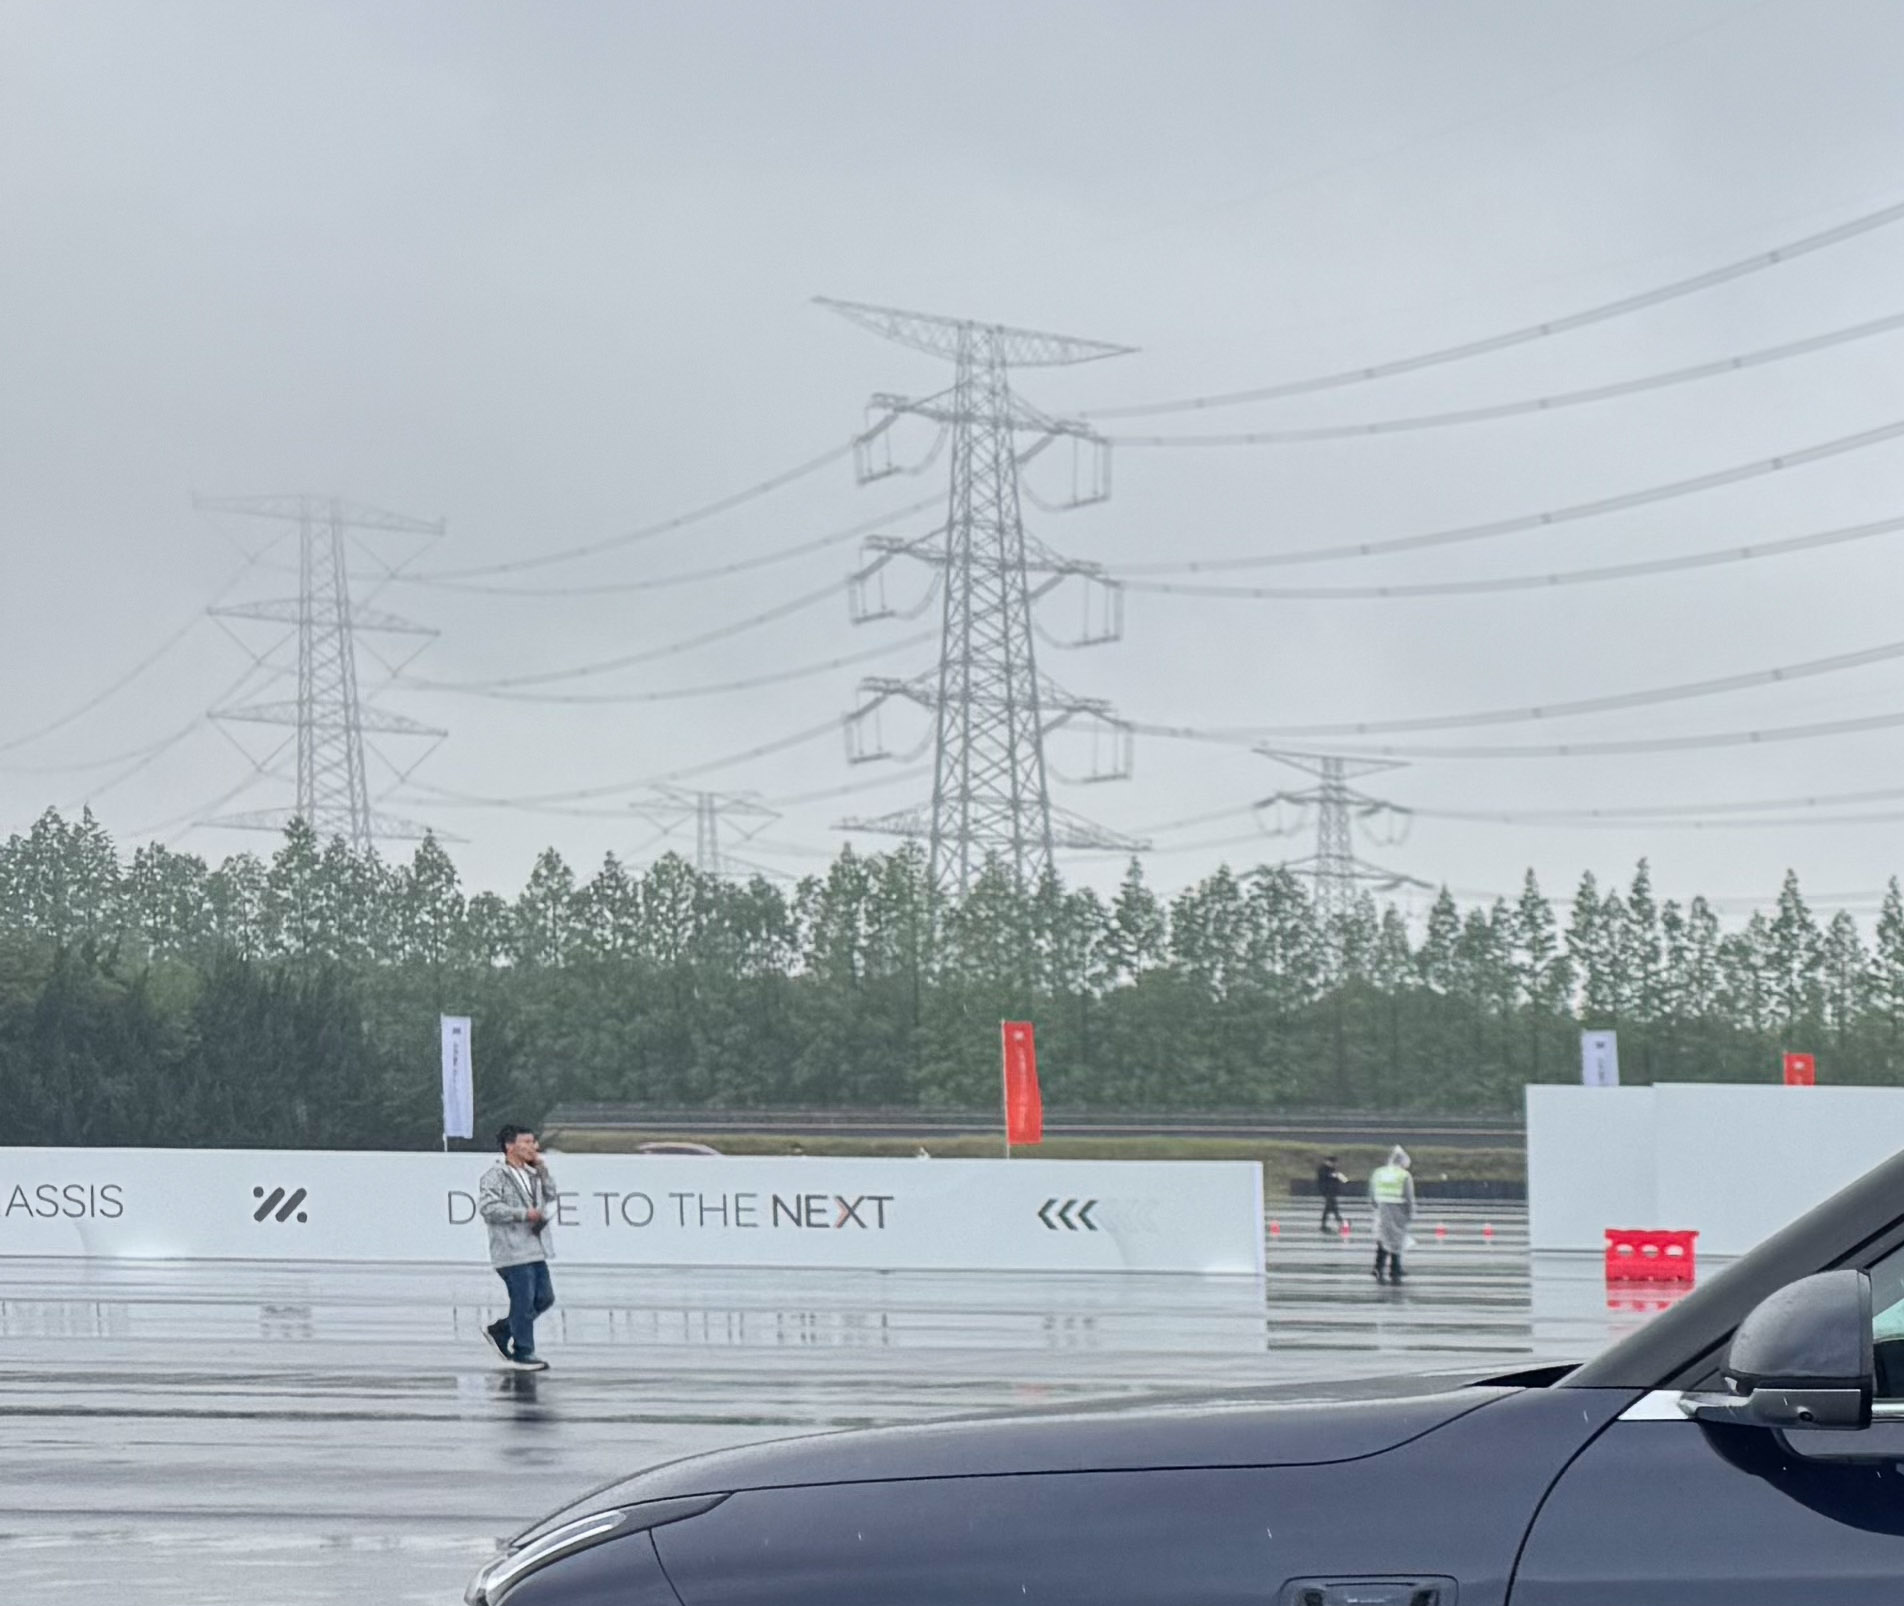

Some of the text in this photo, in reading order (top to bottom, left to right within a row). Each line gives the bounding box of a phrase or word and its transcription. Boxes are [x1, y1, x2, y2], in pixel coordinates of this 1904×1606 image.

[4, 1183, 124, 1219] ASSIS
[592, 1191, 655, 1228] TO
[668, 1191, 760, 1229] THE
[771, 1193, 896, 1230] NEXT
